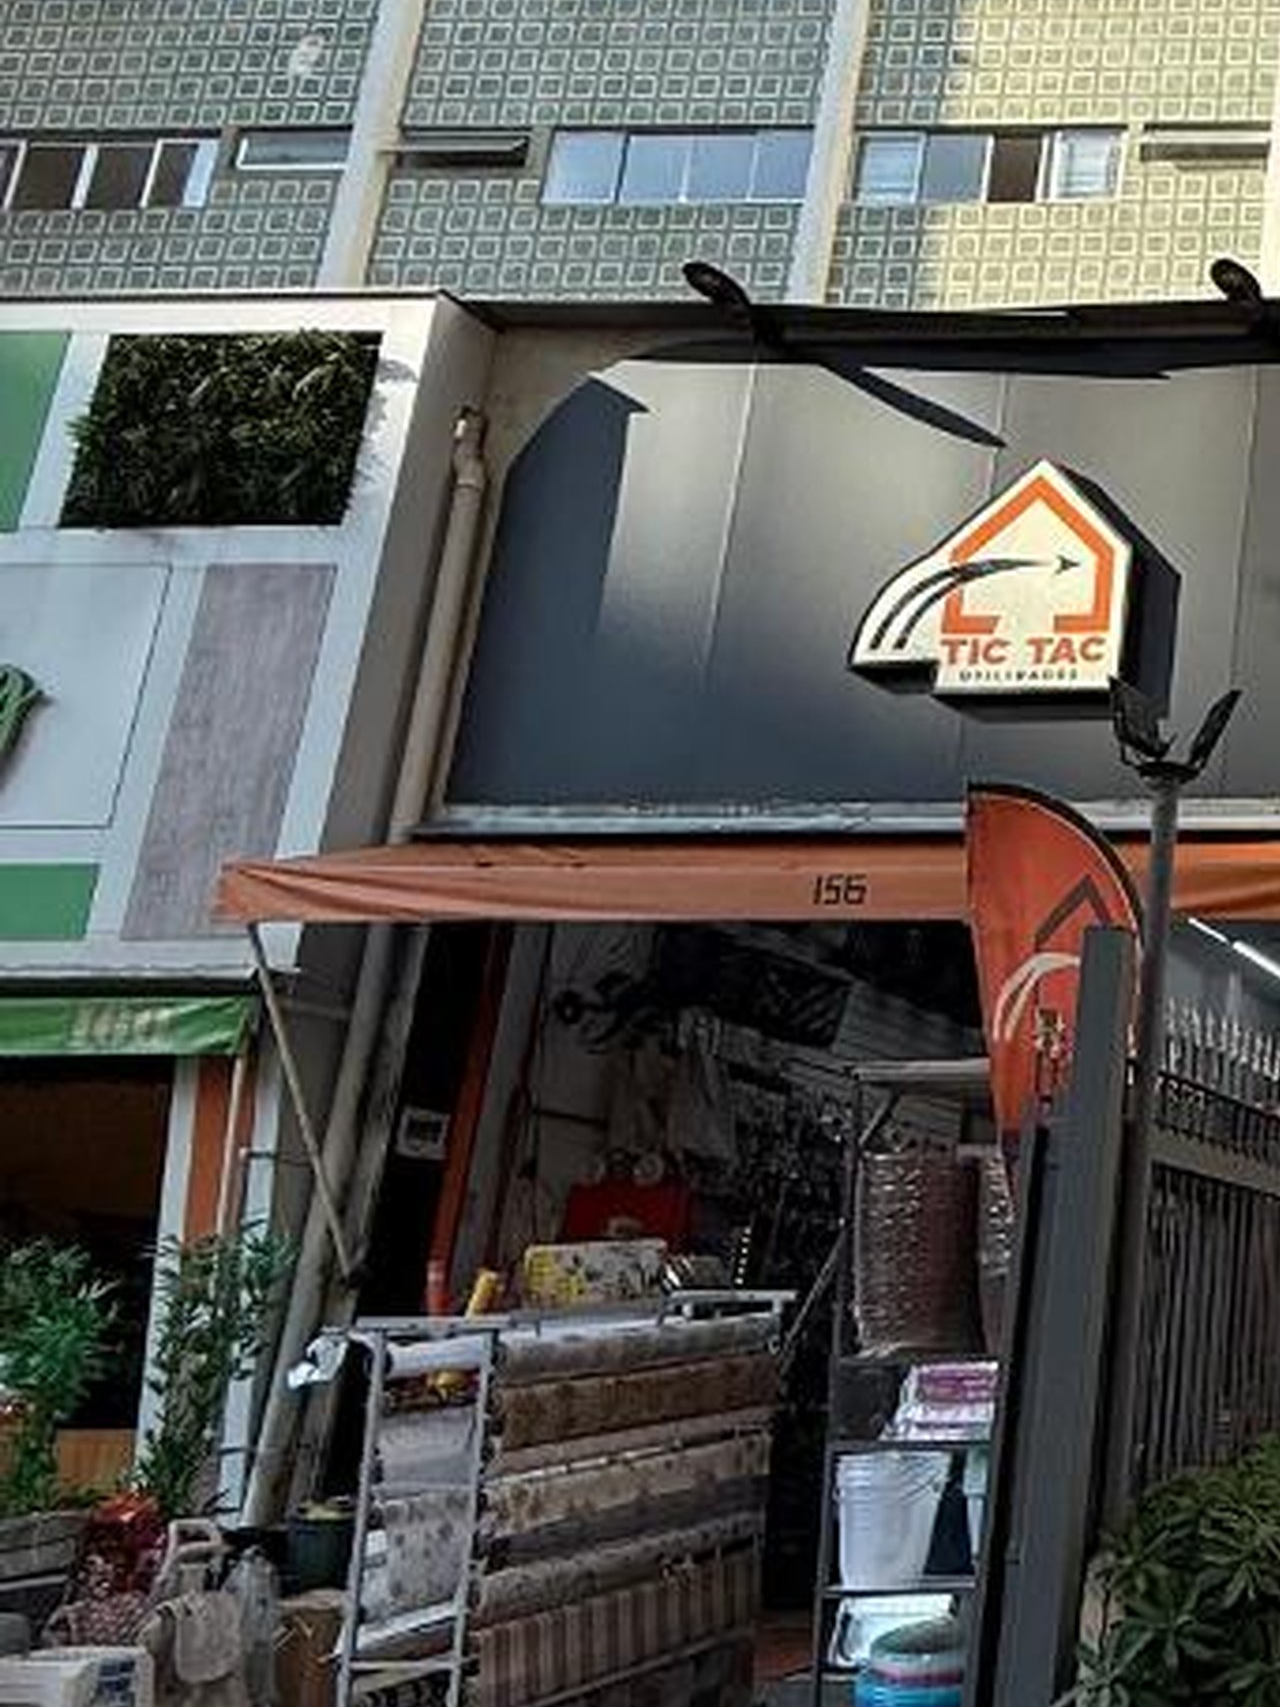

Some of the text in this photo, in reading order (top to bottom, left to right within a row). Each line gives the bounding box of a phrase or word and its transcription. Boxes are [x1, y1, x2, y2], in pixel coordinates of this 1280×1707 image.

[940, 636, 1106, 665] TIC TAC
[812, 873, 867, 905] 156
